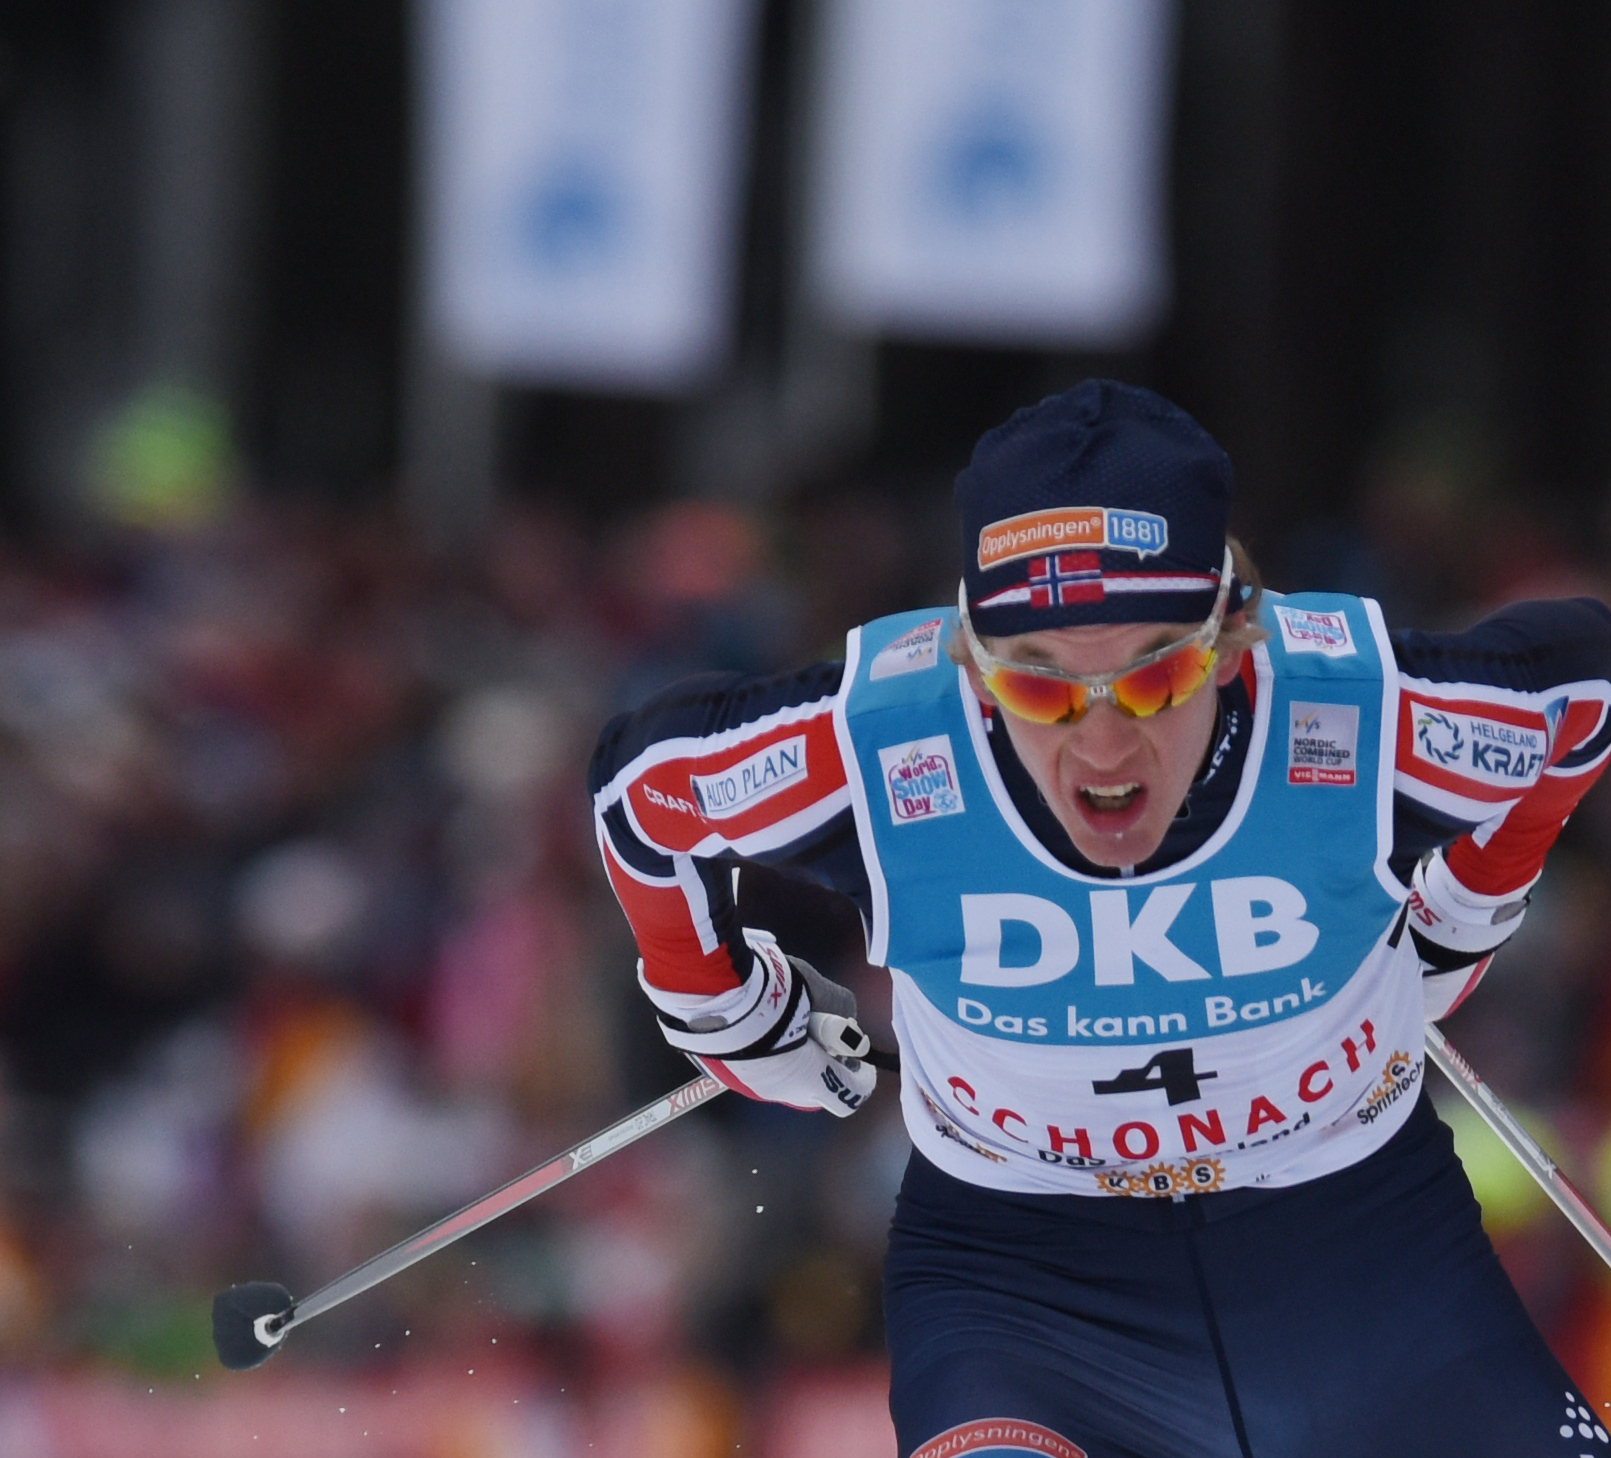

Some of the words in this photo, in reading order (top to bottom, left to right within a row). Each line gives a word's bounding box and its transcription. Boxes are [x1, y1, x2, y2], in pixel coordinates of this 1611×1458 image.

[1110, 517, 1160, 544] 1881
[1294, 738, 1336, 749] NORDIC
[1470, 721, 1538, 748] HELGELAND
[1293, 748, 1350, 759] COMBINED
[1326, 757, 1343, 766] CUP
[1472, 740, 1544, 777] KRAFT
[706, 777, 737, 809] AUTO
[742, 745, 799, 794] PLAN
[898, 757, 938, 780] World
[892, 770, 947, 800] Snow
[643, 783, 697, 818] CRAFT
[903, 796, 931, 817] Day
[959, 875, 1321, 987] DKB
[957, 996, 1048, 1037] Das
[1067, 1005, 1188, 1038] kann
[1204, 978, 1327, 1028] Bank
[1091, 1047, 1218, 1106] 4
